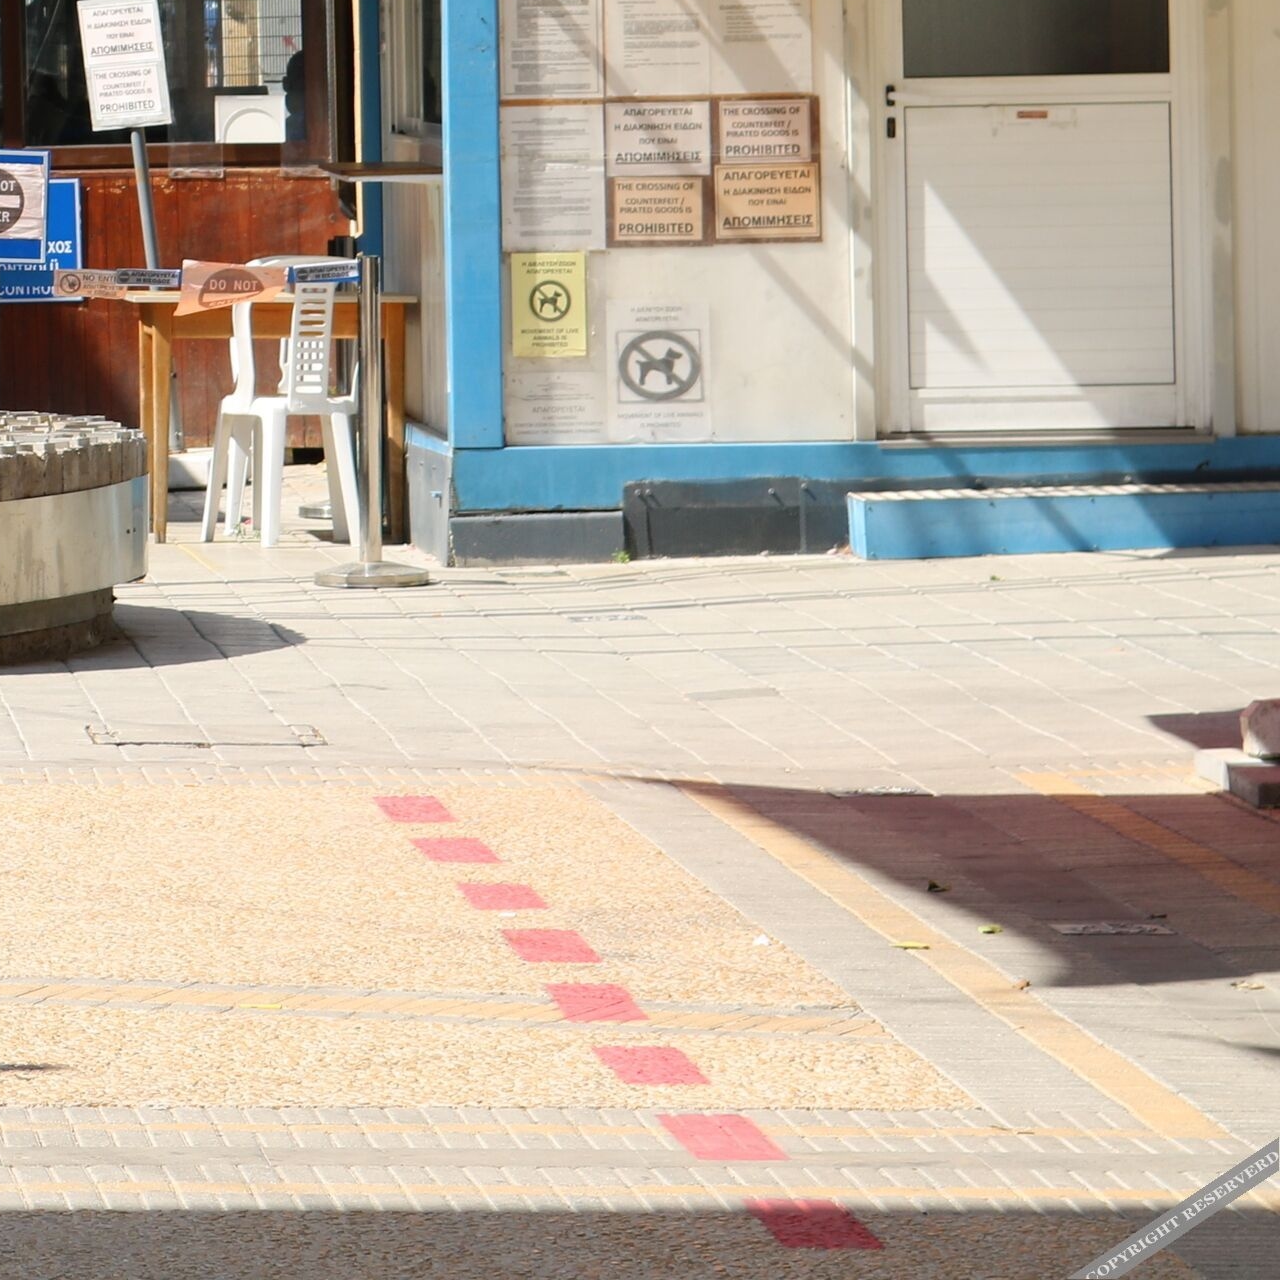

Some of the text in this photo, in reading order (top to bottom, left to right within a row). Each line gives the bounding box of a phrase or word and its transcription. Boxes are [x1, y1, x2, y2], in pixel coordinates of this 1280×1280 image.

[93, 7, 143, 17] ΑΠΑΓΟΡΕΥΕΤΑΙ
[91, 41, 154, 55] ΑΠΟΜΙΜΗΣΕΙΣ
[109, 70, 141, 79] CROSSING
[143, 68, 152, 76] OF
[100, 100, 155, 112] PROHIBITED
[742, 107, 787, 115] CROSSING
[789, 107, 800, 115] OF
[623, 108, 693, 116] ΑΠΑΓΟΡΕΥΕΤΑΙ
[623, 123, 672, 131] ΔΙΑΚΙΝΗΣΗ
[732, 121, 785, 129] COUNTERFEIT
[726, 129, 759, 137] PIRATED
[760, 129, 790, 137] GOODS
[725, 144, 800, 155] PROHIBITED
[615, 151, 702, 163] ΑΠΟΜΙΜΗΣΕΙΣ
[724, 170, 810, 181] ΑΠΑΓΟΡΕΥΕΤΑΙ
[616, 182, 695, 191] THE CROSSING OF
[732, 187, 781, 195] ΔΙΑΚΙΝΗΣΗ
[619, 206, 652, 214] PIRATED
[654, 206, 684, 214] GOODS
[723, 215, 814, 228] ΑΠΟΜΙΜΗΣΕΙΣ
[618, 223, 694, 234] PROHIBITED
[82, 274, 95, 282] NO
[209, 280, 258, 290] DO NOT
